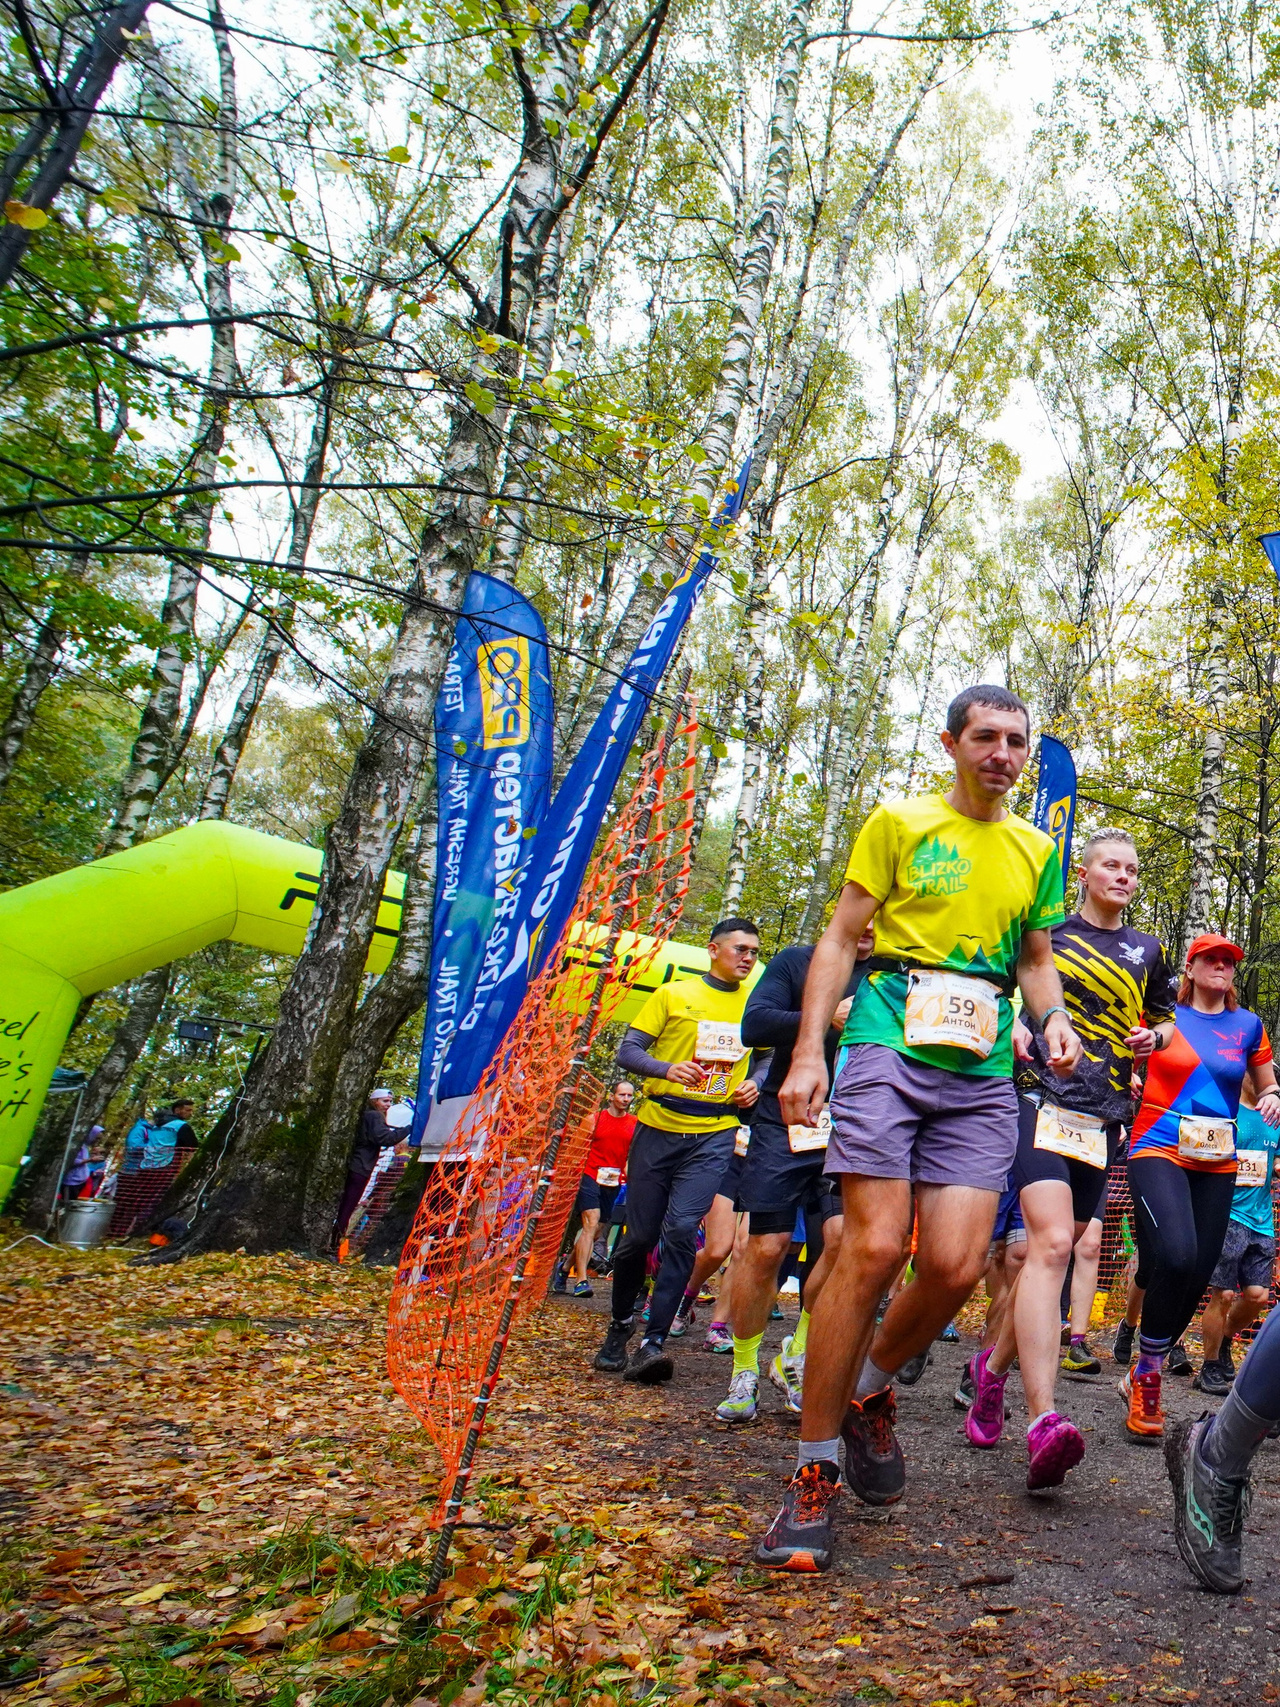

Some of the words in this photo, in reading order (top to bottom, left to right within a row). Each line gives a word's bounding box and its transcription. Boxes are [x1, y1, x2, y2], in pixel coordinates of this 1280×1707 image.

[908, 859, 971, 881] BLIZKO
[915, 875, 968, 897] TRAIL
[1040, 902, 1064, 918] BLIZ
[948, 996, 975, 1016] 59
[718, 1035, 733, 1046] 63
[1207, 1130, 1215, 1141] 8
[1238, 1162, 1257, 1172] 131
